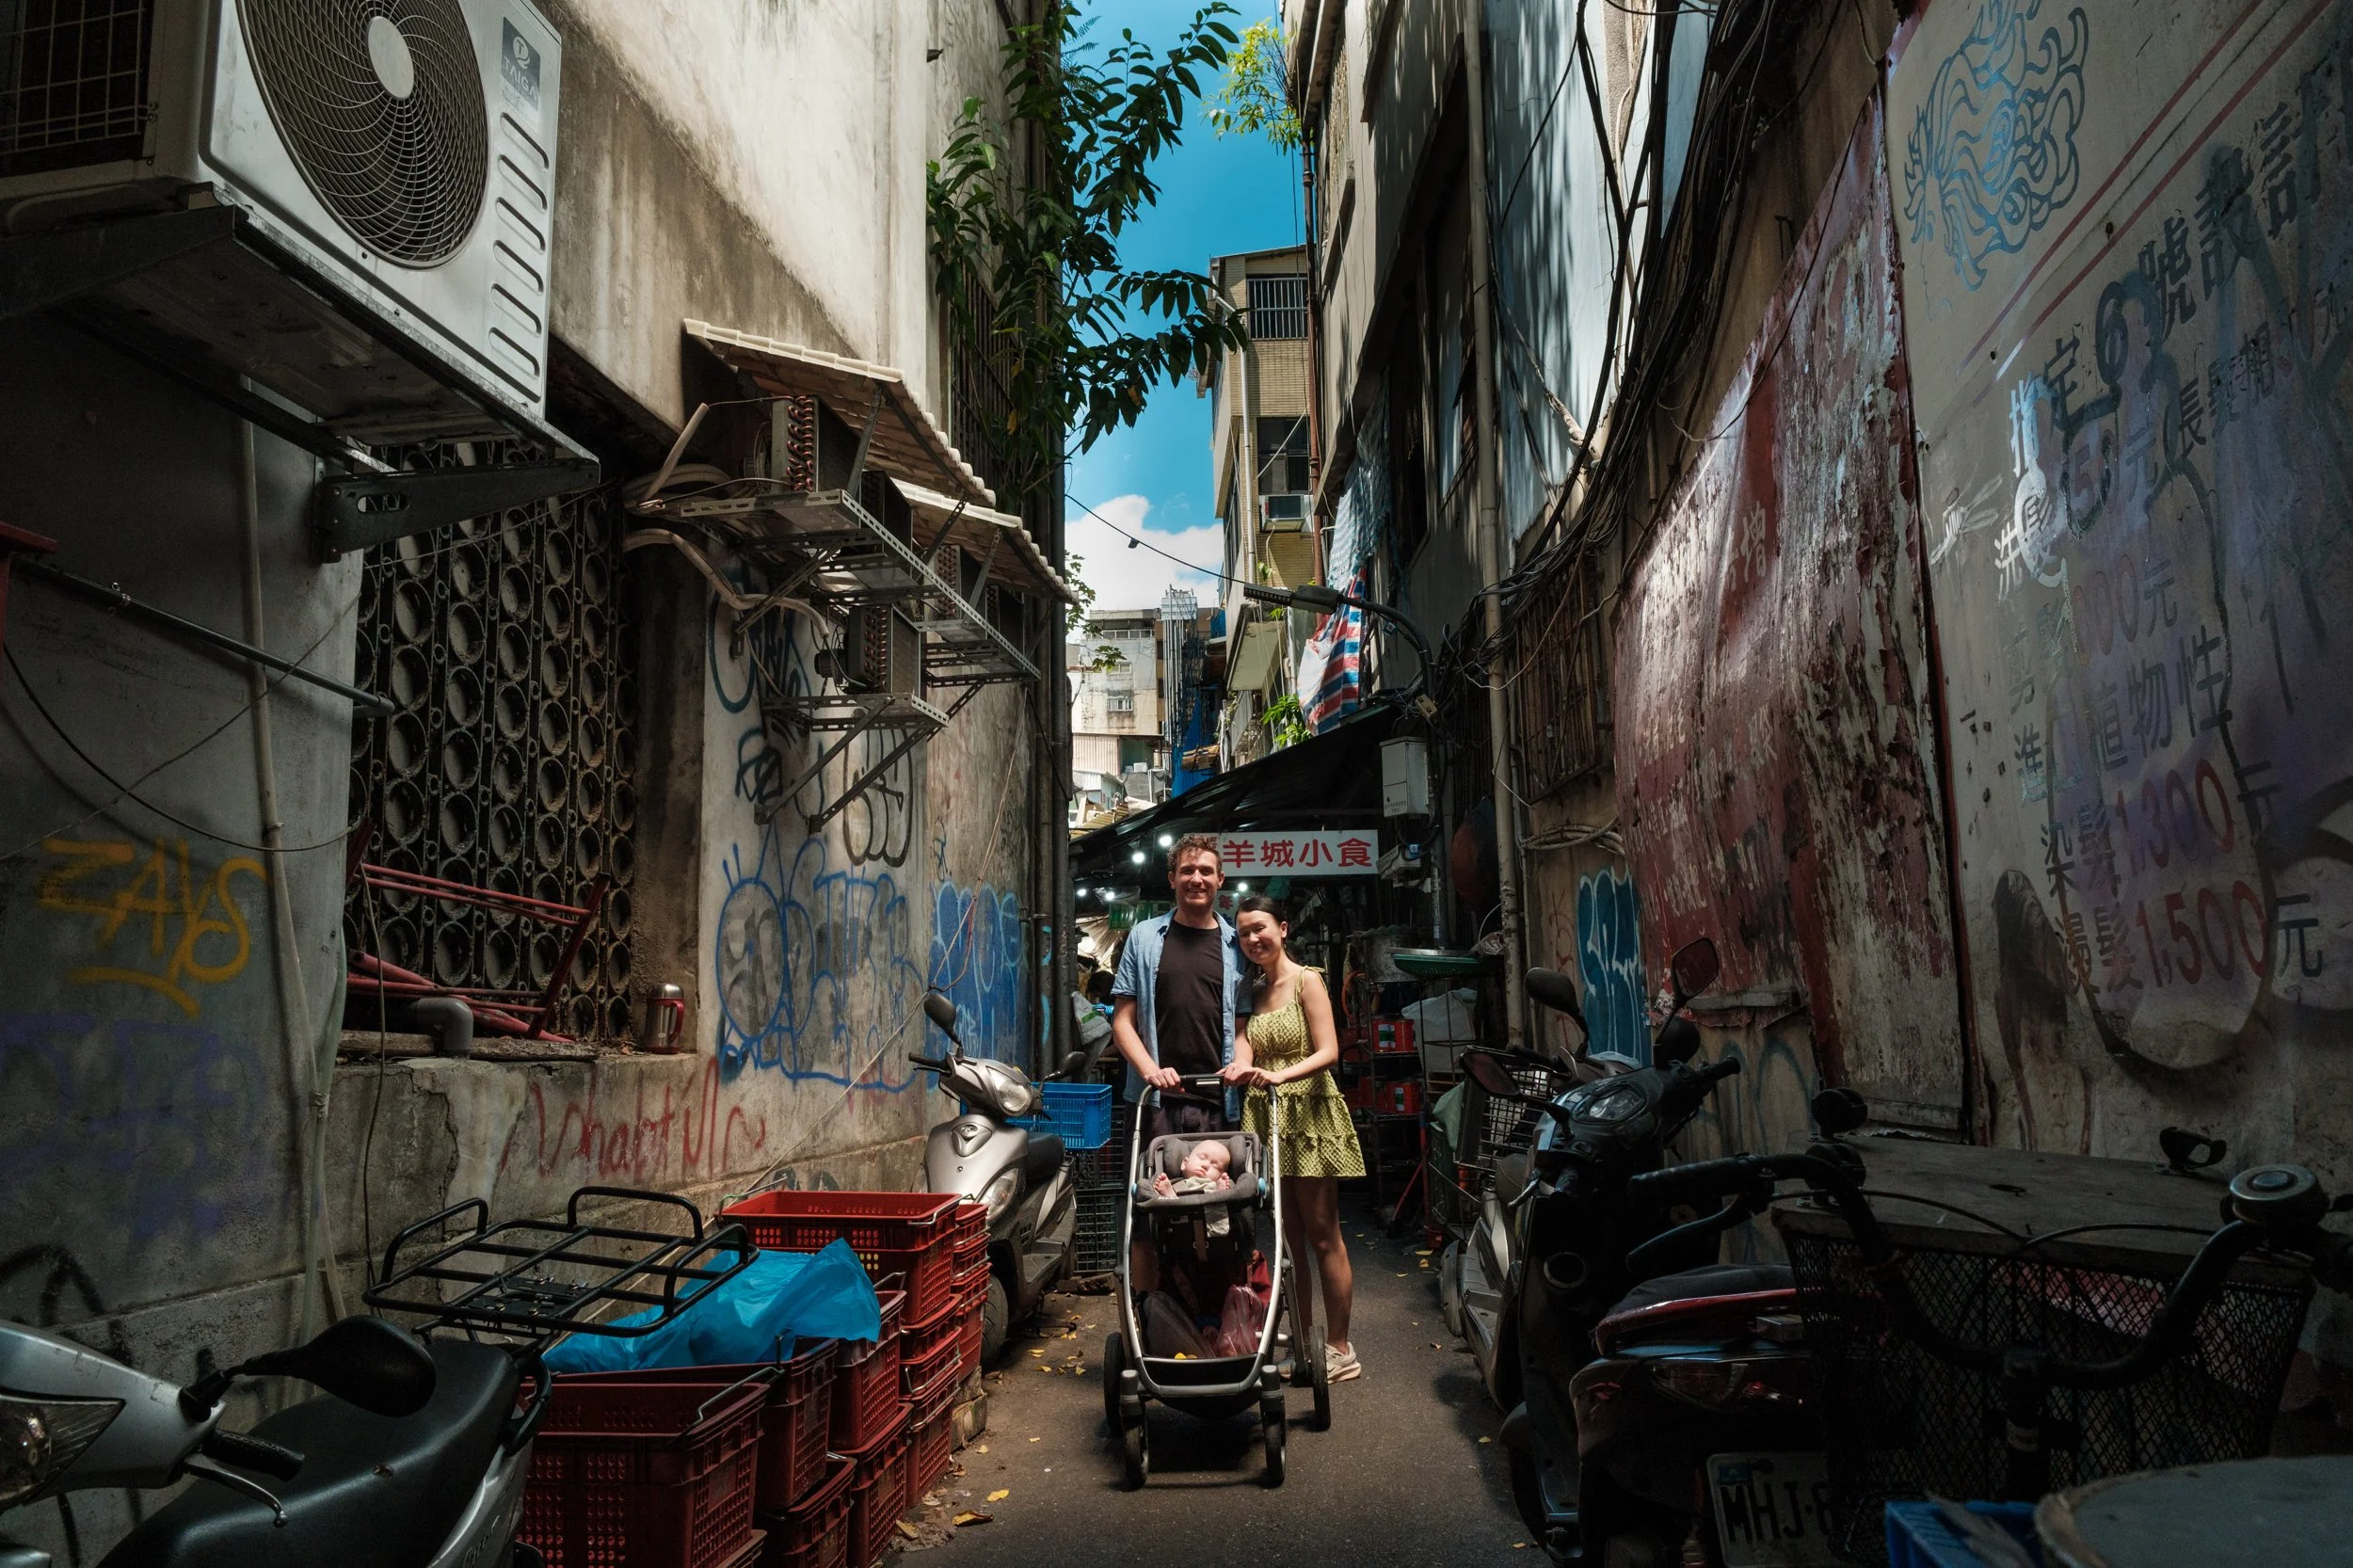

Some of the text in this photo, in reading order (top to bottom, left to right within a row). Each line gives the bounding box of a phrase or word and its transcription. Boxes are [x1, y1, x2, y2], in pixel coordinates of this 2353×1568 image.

[504, 56, 538, 101] TAIGA
[1209, 836, 1372, 868] 羊城小食
